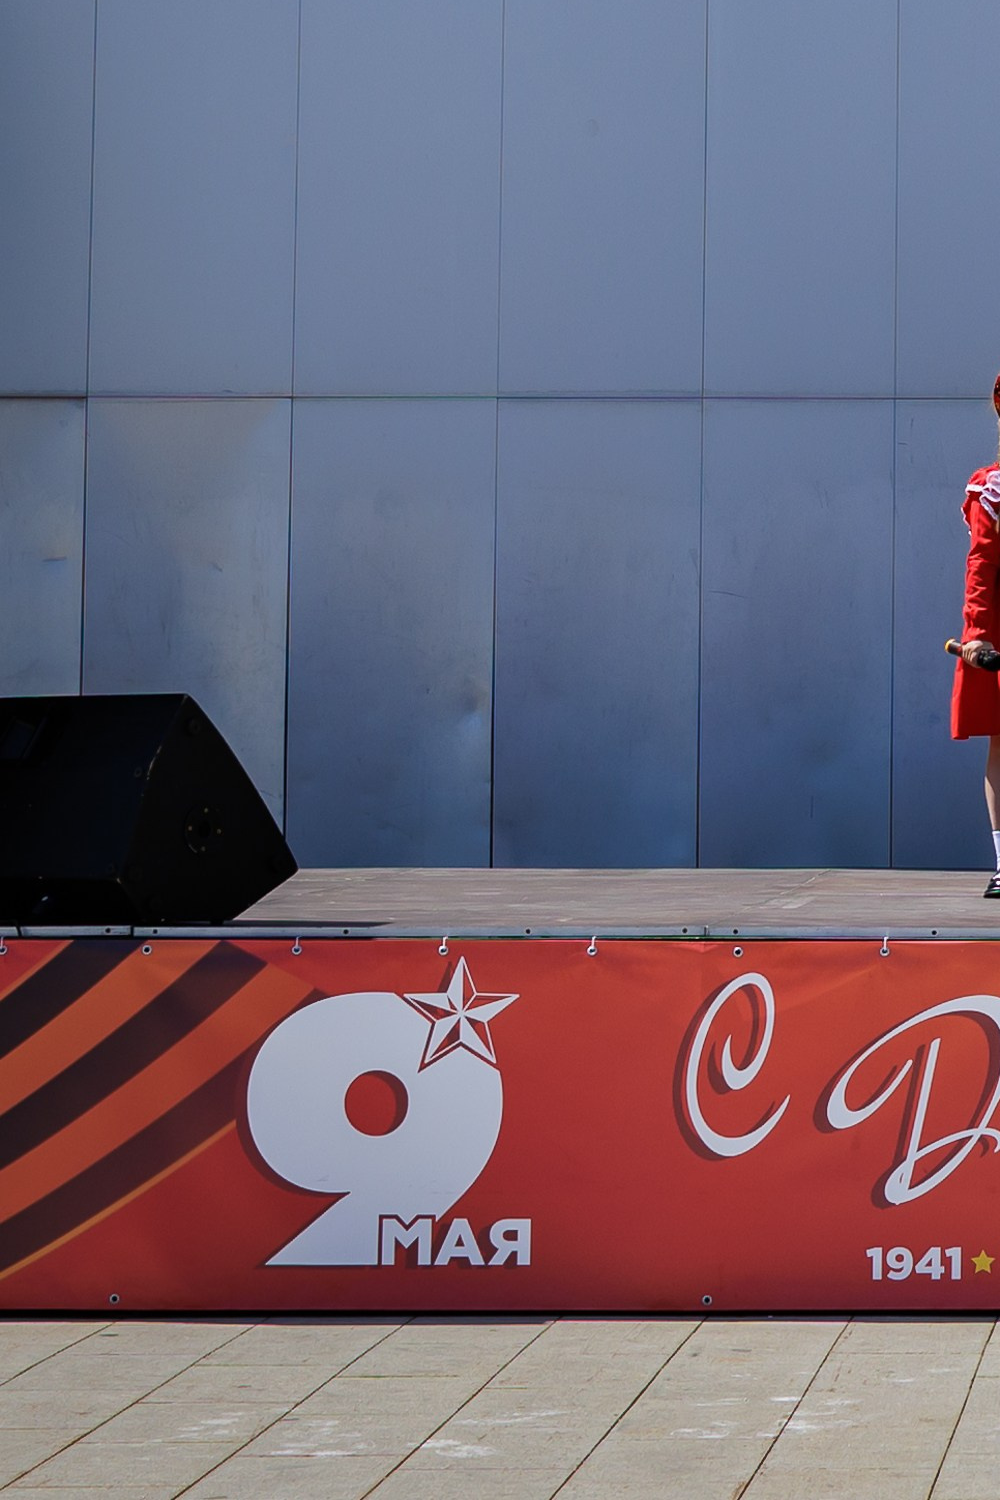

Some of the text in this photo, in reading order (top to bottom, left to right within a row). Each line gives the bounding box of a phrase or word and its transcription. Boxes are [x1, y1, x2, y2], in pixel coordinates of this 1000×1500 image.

[686, 972, 790, 1157] С
[247, 991, 503, 1266] 9
[380, 1218, 532, 1266] МАЯ
[866, 1246, 962, 1281] 1941
